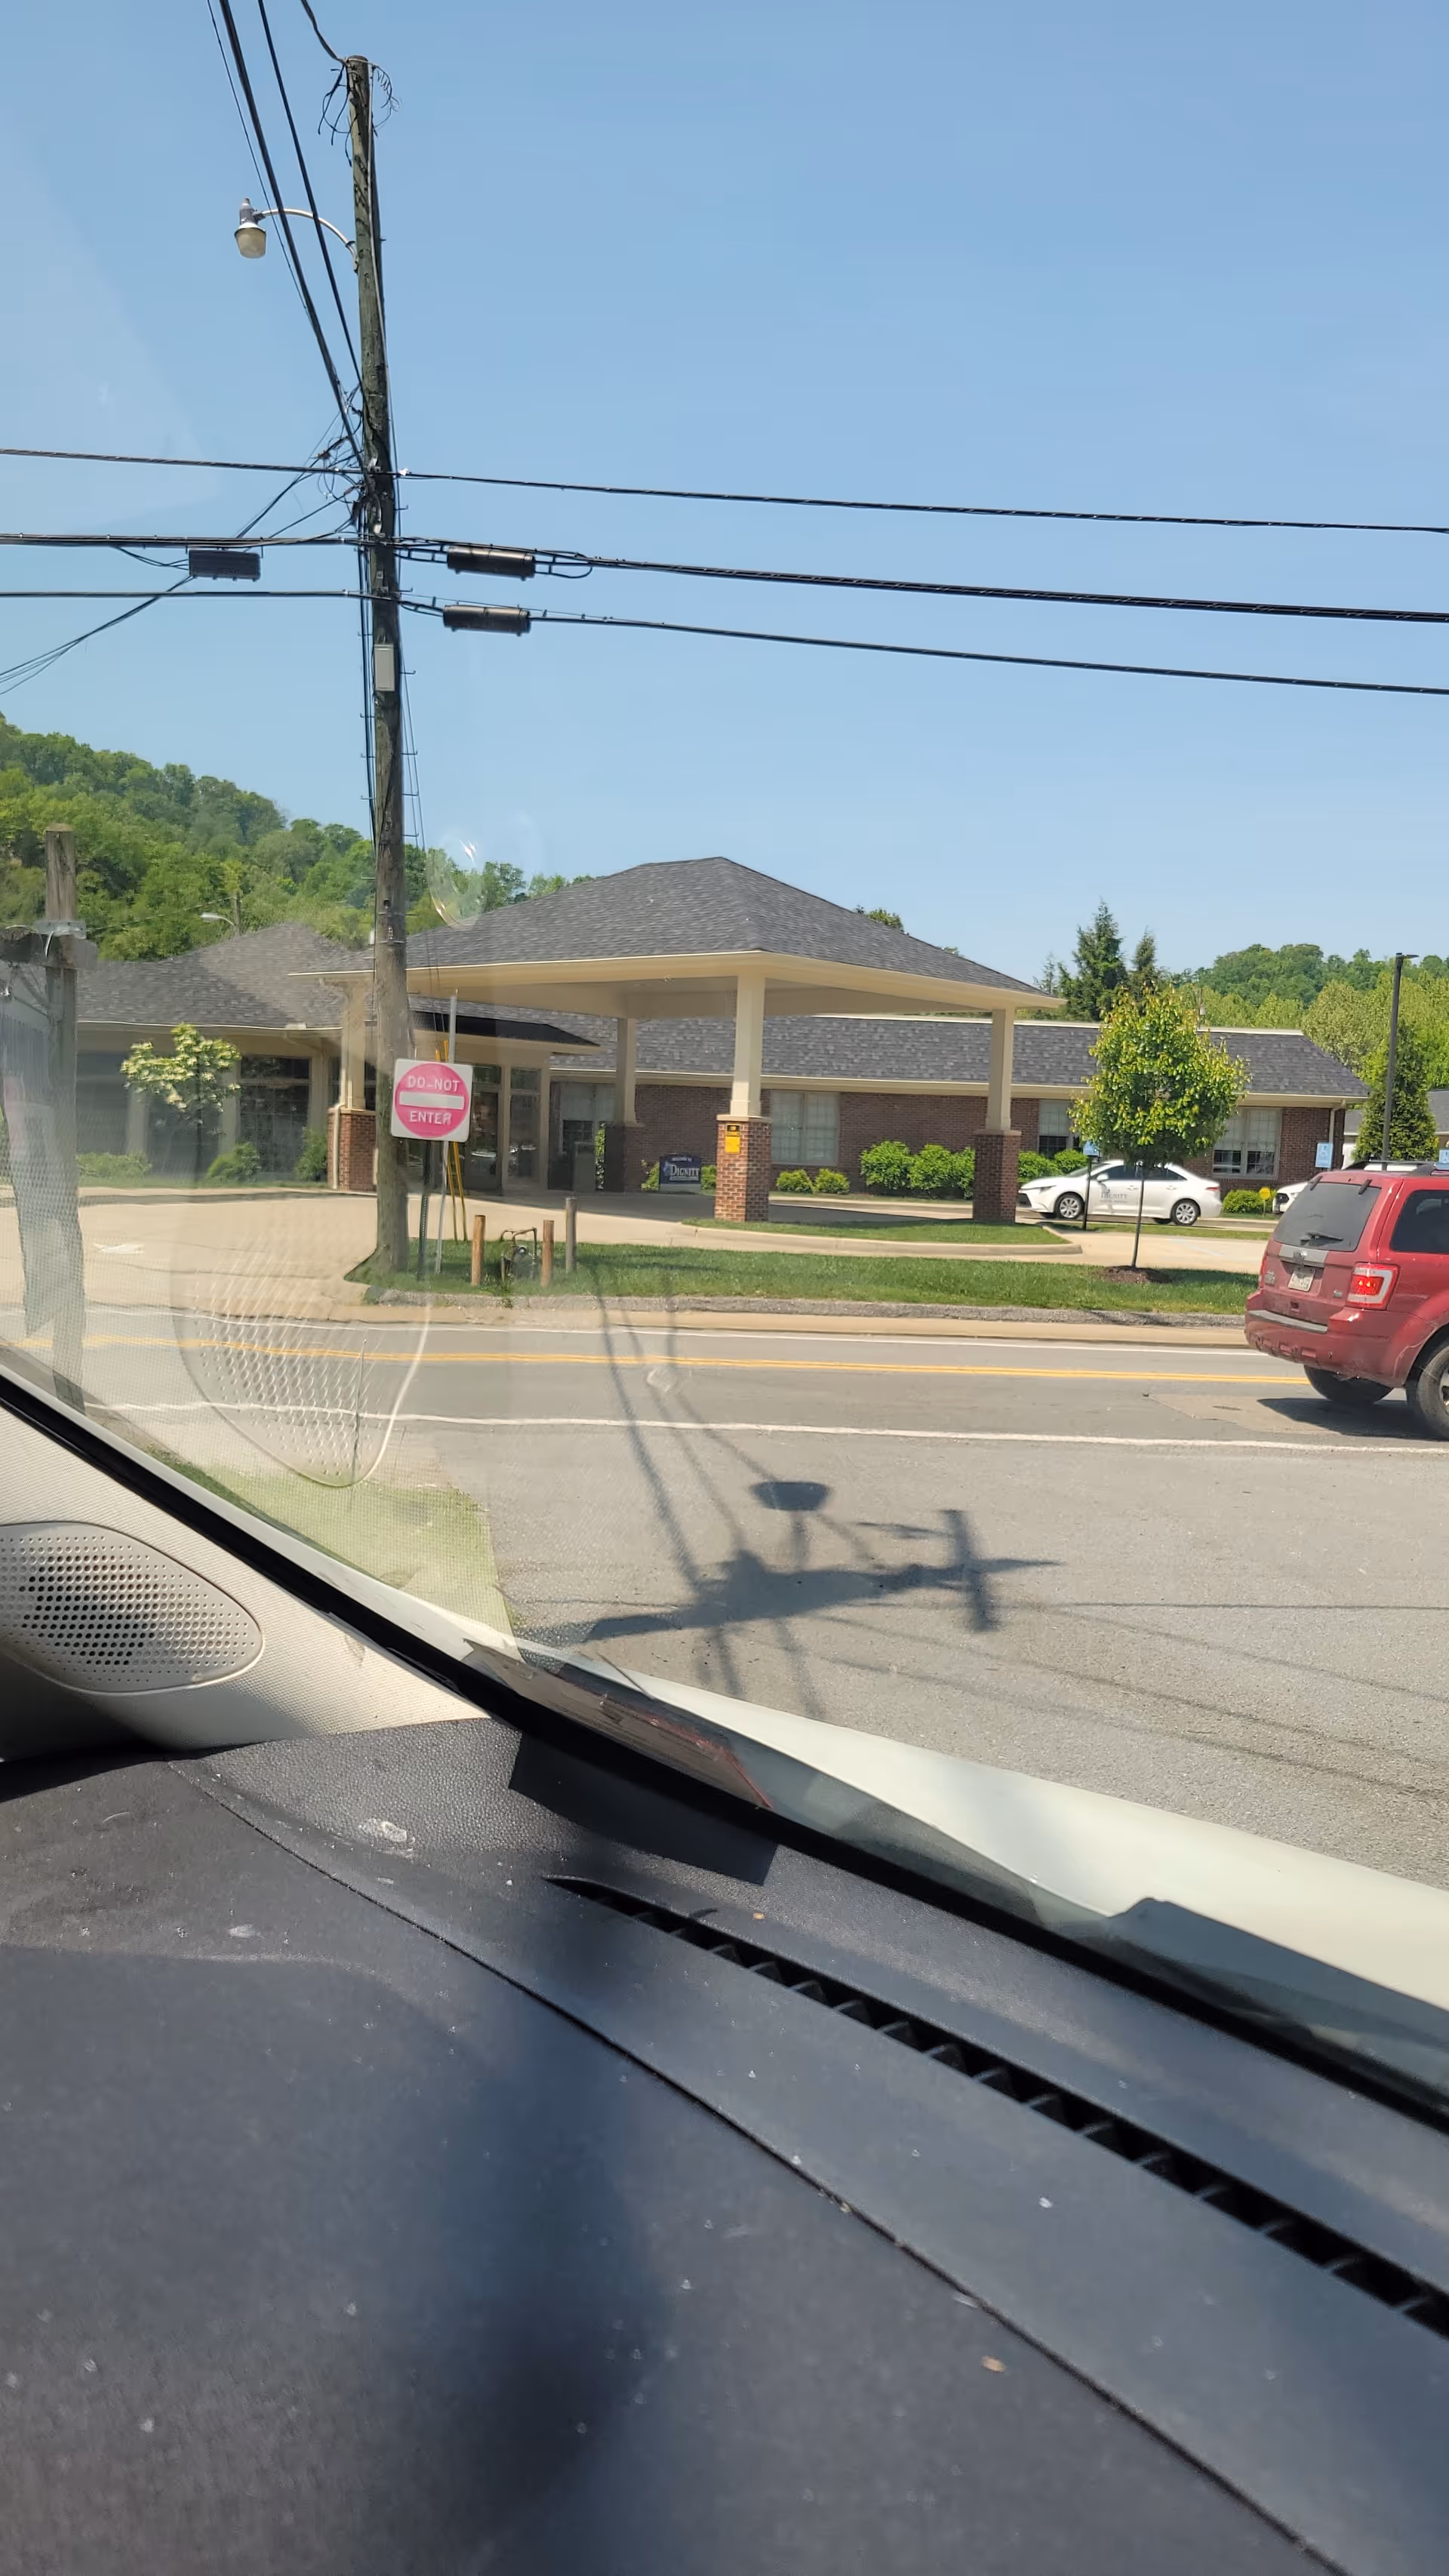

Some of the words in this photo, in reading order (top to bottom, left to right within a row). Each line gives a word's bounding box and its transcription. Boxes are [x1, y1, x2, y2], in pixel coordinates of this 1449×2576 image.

[408, 1076, 426, 1088] DO
[434, 1079, 460, 1092] NOT
[410, 1111, 452, 1125] ENTER
